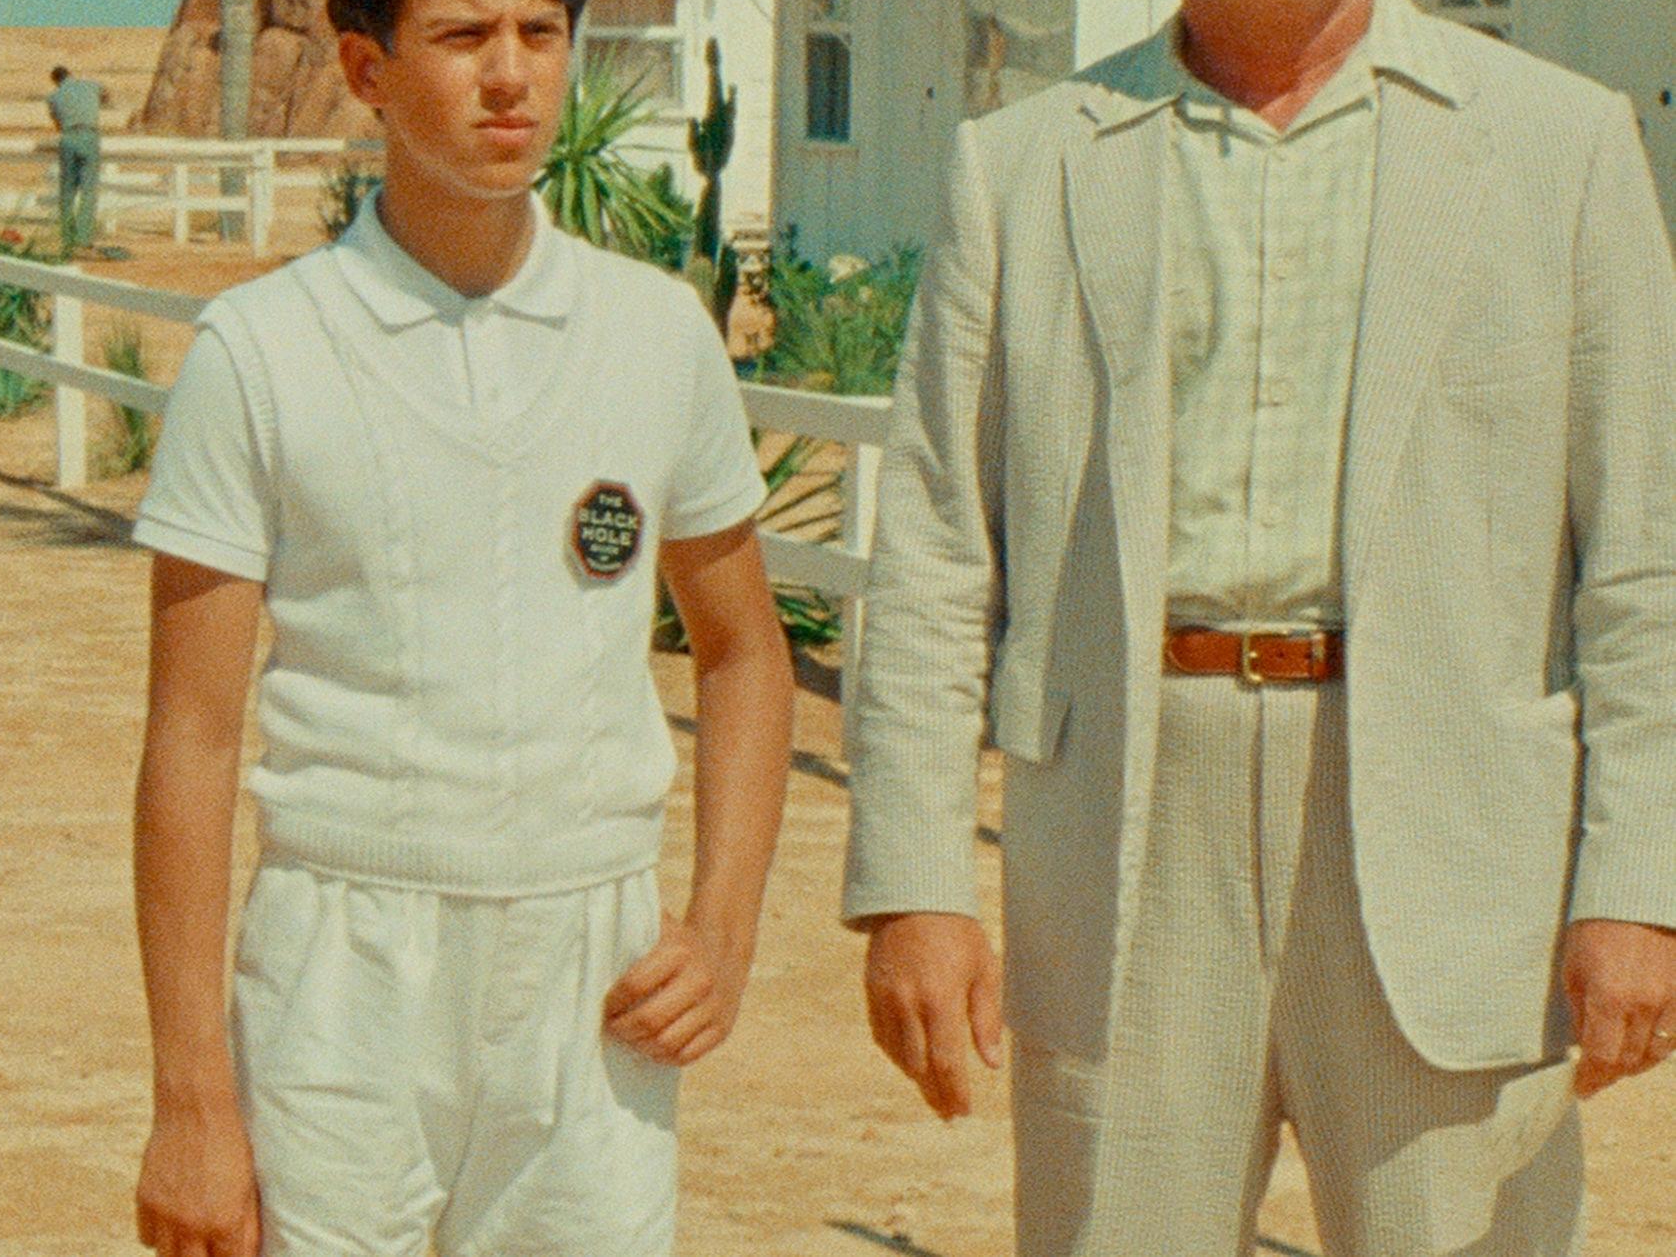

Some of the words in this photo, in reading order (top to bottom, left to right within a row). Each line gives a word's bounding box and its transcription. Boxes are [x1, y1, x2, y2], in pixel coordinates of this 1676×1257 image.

[599, 493, 623, 508] THE
[578, 508, 638, 529] BLACK
[583, 528, 631, 546] HOLE
